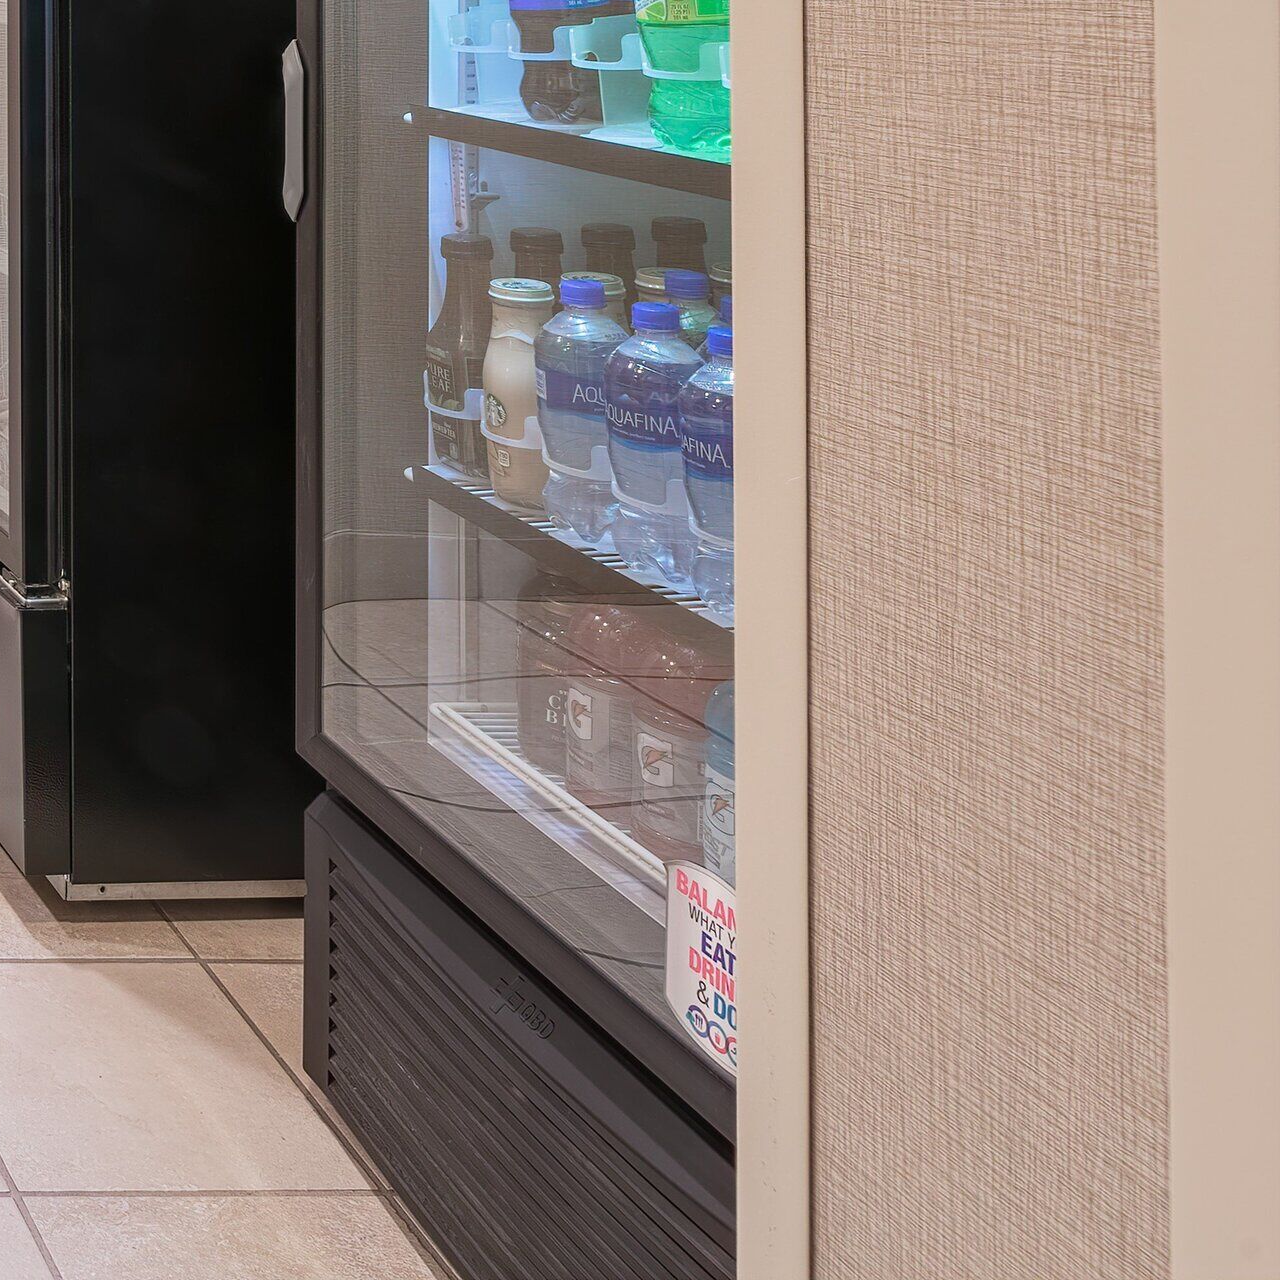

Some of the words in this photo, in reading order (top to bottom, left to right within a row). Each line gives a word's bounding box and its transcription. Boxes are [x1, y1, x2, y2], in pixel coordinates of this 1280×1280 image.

[682, 434, 729, 469] AFINA
[676, 868, 737, 933] BALAN
[689, 902, 725, 941] WHAT
[701, 930, 737, 976] EAT
[689, 946, 736, 1003] DRIN
[696, 980, 710, 1009] &
